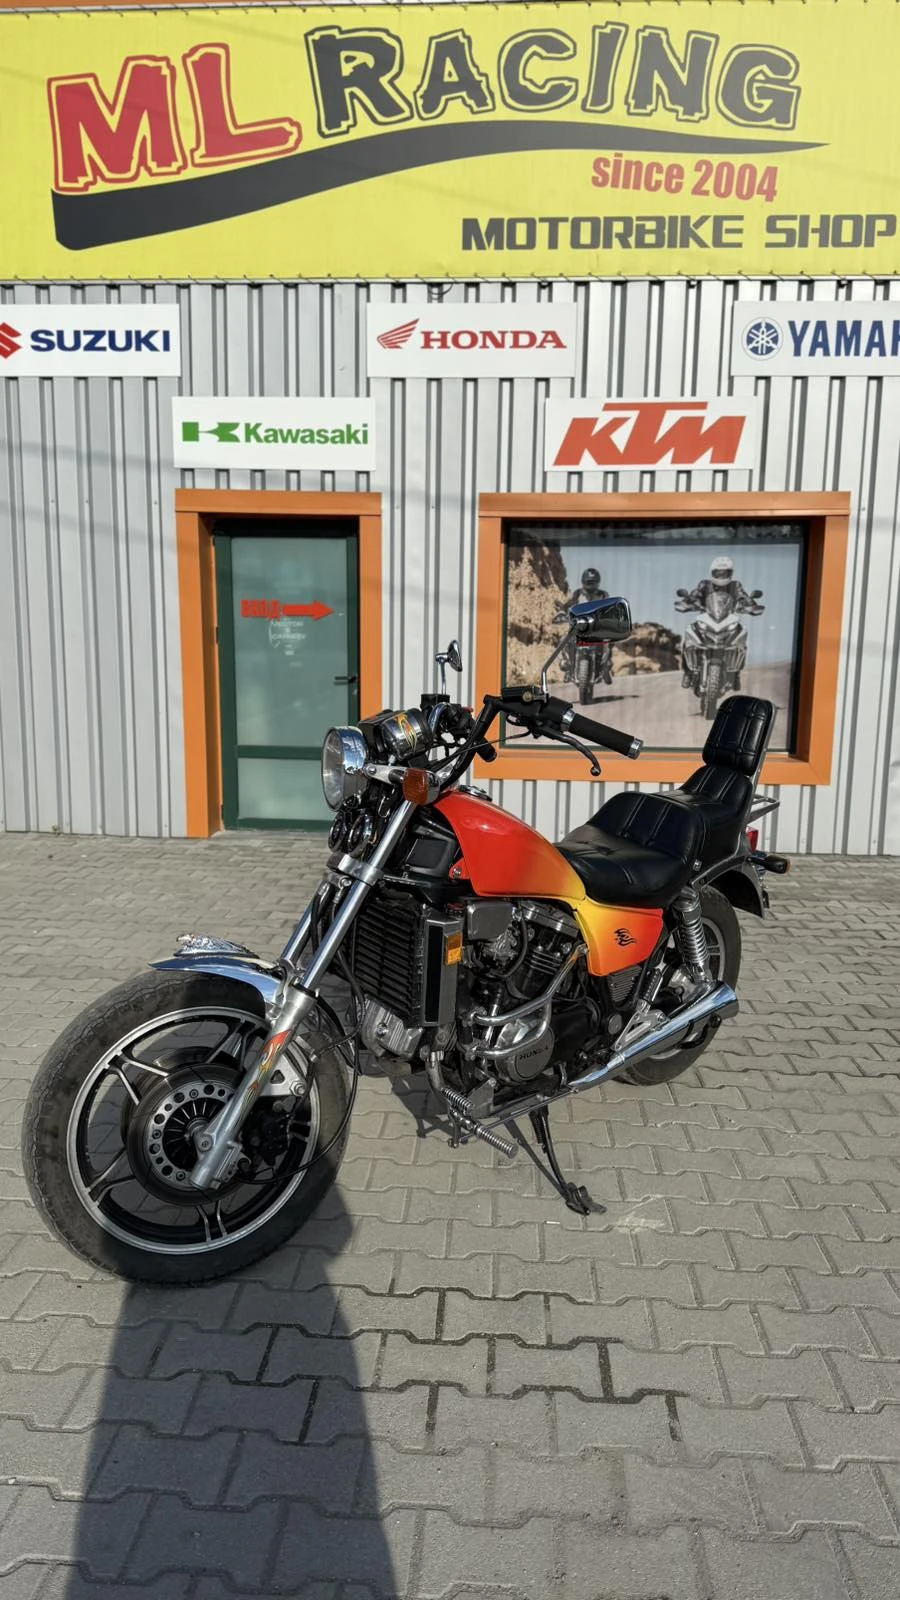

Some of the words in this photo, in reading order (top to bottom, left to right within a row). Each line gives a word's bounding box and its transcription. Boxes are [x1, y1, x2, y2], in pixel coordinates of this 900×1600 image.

[47, 43, 303, 193] ML
[304, 21, 802, 138] RACING
[591, 152, 685, 194] since
[691, 159, 778, 202] 2004
[461, 214, 744, 250] MOTORBIKE
[764, 213, 897, 248] SHOP
[30, 329, 170, 352] SUZUKI
[421, 329, 567, 350] HONDA
[244, 421, 369, 445] Kawasaki
[553, 401, 746, 466] KTM
